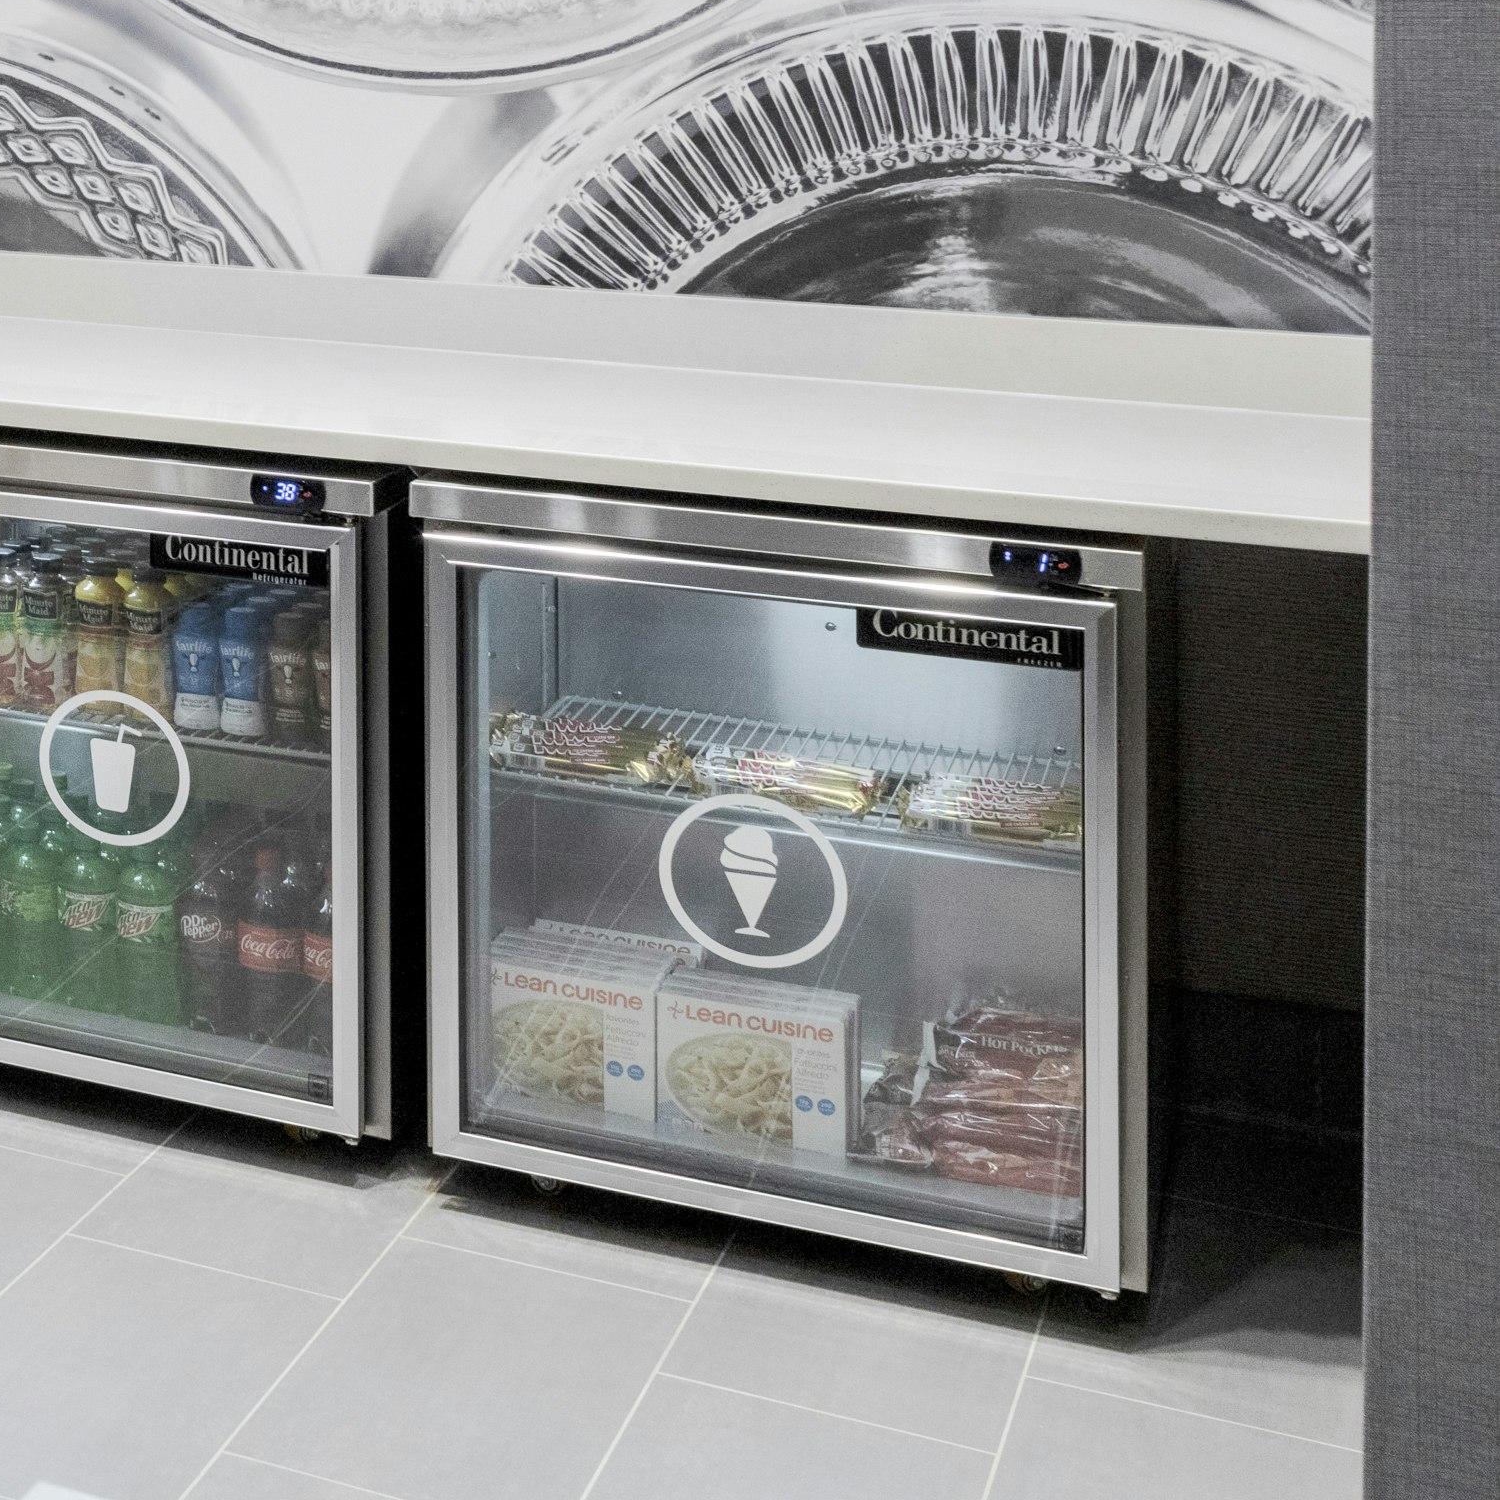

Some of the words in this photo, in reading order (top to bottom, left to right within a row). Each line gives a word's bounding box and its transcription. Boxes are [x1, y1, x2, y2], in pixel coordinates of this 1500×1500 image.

[276, 482, 297, 502] 38
[165, 534, 310, 575] Continental
[252, 572, 308, 587] Refrigerator
[25, 595, 54, 608] Minute
[28, 605, 50, 617] Maid
[79, 603, 109, 616] Minute
[82, 612, 104, 623] Maid
[126, 612, 159, 624] Minute
[130, 620, 154, 632] Maid
[872, 608, 1063, 656] Continental
[176, 640, 214, 655] fairlife
[221, 645, 255, 660] fairlife
[270, 652, 307, 668] fairlife
[1017, 657, 1063, 669] FREEZER
[183, 915, 218, 939] Pepper
[192, 914, 207, 928] Dr
[241, 934, 296, 959] Coca-Cola
[503, 971, 557, 997] Lean
[561, 983, 643, 1010] cuisine
[605, 1024, 646, 1038] Fettuccini
[685, 1005, 743, 1029] Lean
[746, 1014, 834, 1043] cuisine
[606, 1034, 639, 1047] Alfredo
[981, 1036, 1008, 1050] HOT
[795, 1067, 829, 1080] Alfredo
